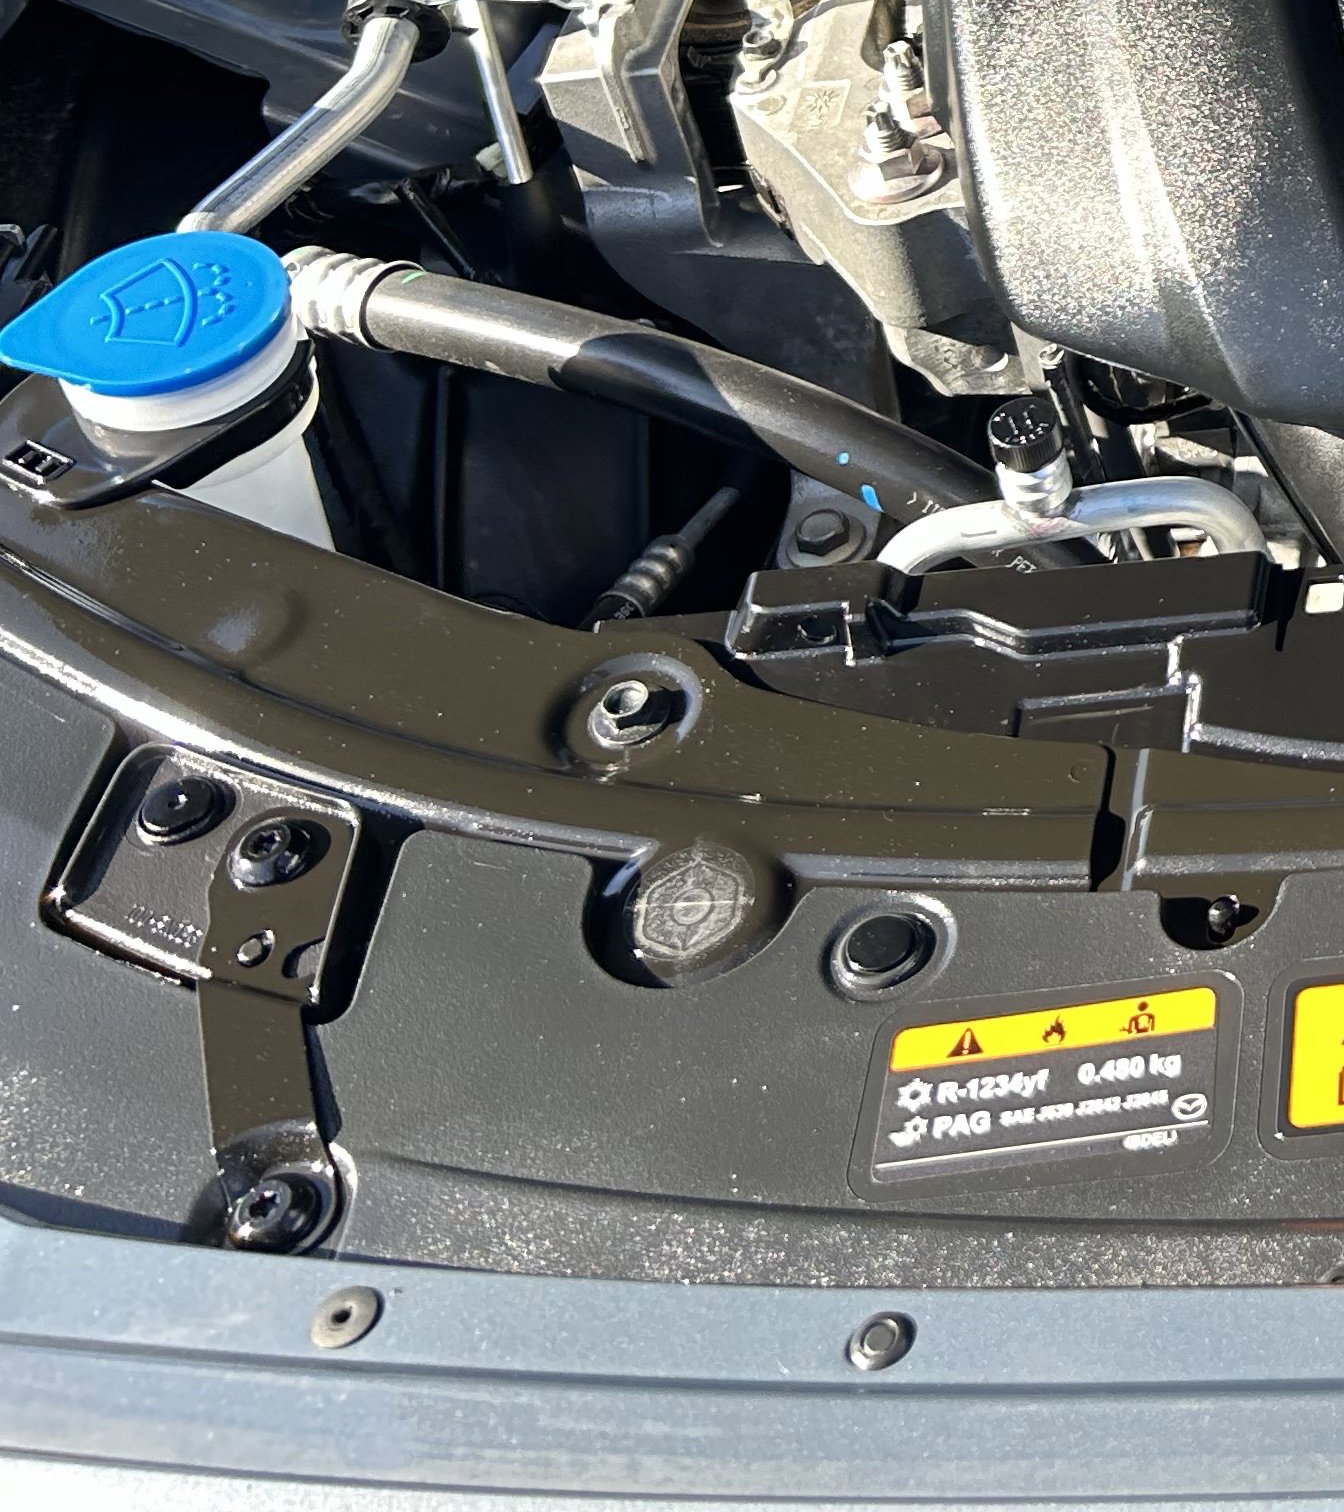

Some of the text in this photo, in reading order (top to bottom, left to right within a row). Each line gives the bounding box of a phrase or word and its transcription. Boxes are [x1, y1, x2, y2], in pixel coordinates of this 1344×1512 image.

[937, 1068, 1050, 1106] R-1234yf
[1149, 1053, 1182, 1079] kg
[931, 1110, 992, 1140] PAG
